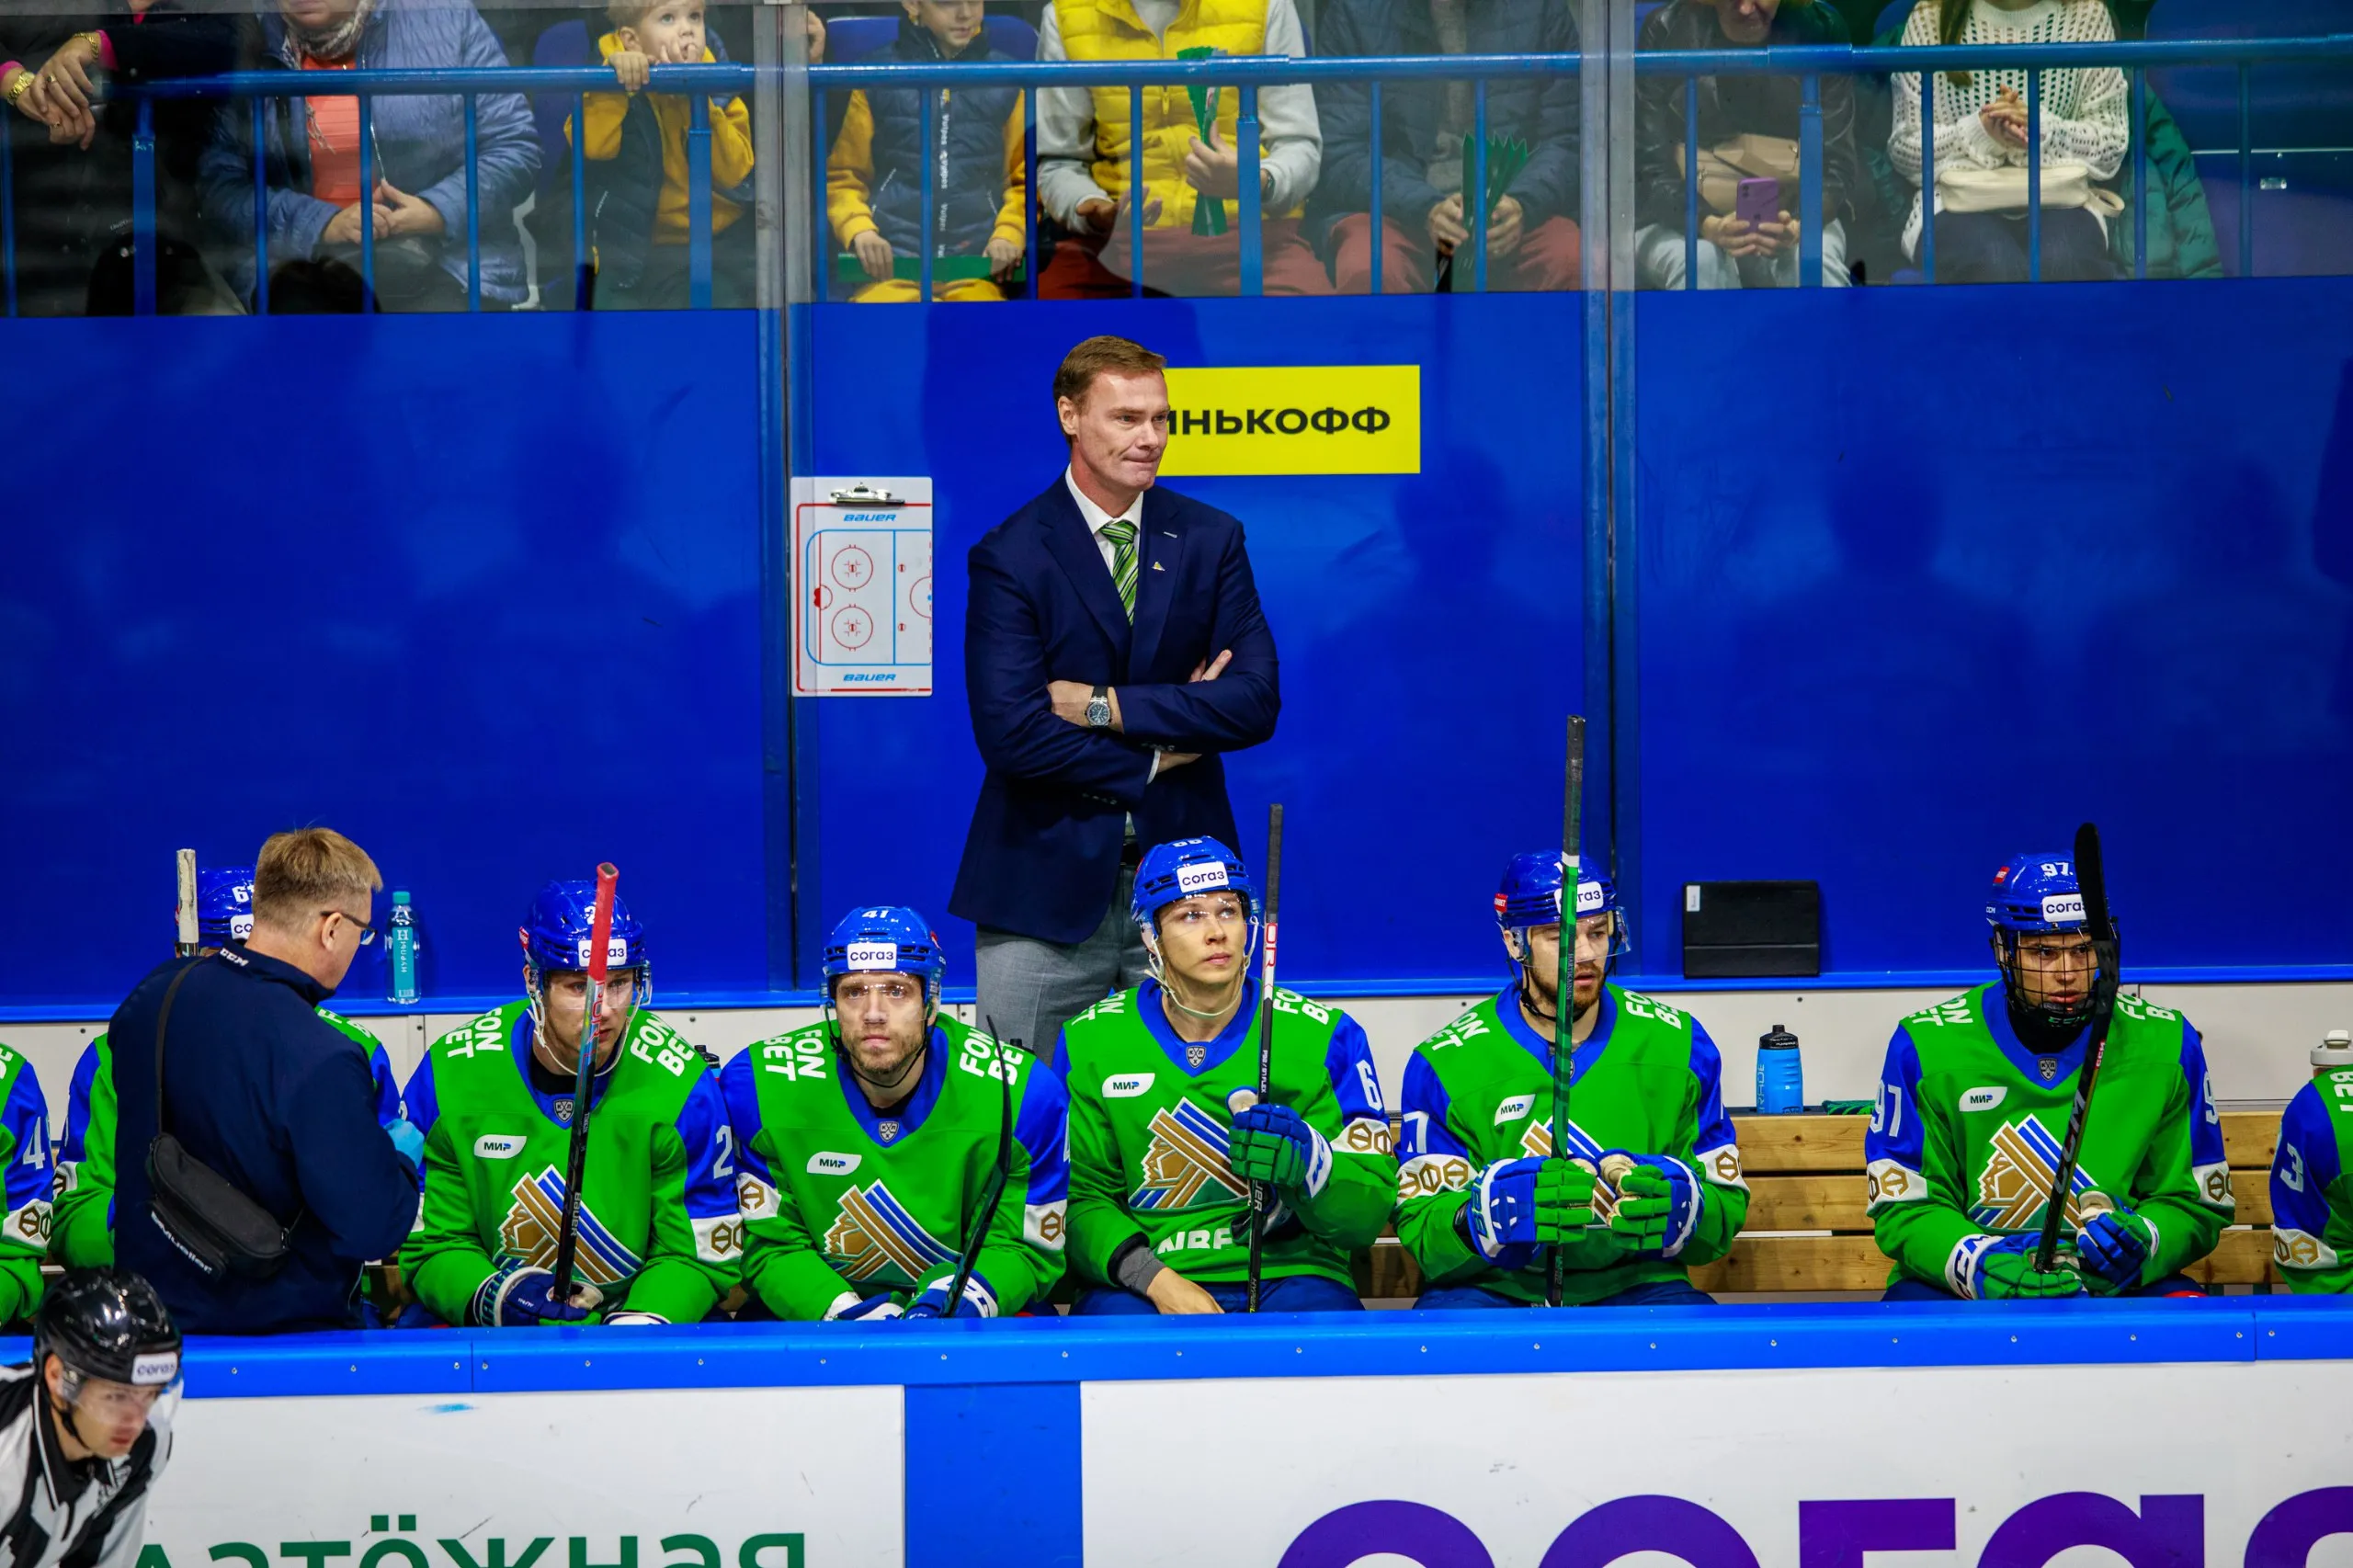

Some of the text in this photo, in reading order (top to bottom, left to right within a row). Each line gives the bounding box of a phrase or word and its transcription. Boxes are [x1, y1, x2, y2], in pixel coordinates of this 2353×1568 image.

[1166, 407, 1390, 435] НЬКОФФ
[1182, 870, 1225, 886] согаз
[862, 910, 889, 919] 41
[2045, 902, 2086, 915] сога
[581, 945, 625, 960] саз
[849, 949, 894, 961] согаз
[1112, 1081, 1141, 1090] МИР
[1970, 1095, 1994, 1105] МИР
[1500, 1103, 1525, 1115] МИР
[1870, 1079, 1903, 1138] 97
[483, 1142, 512, 1152] МИР
[819, 1158, 847, 1169] МИР
